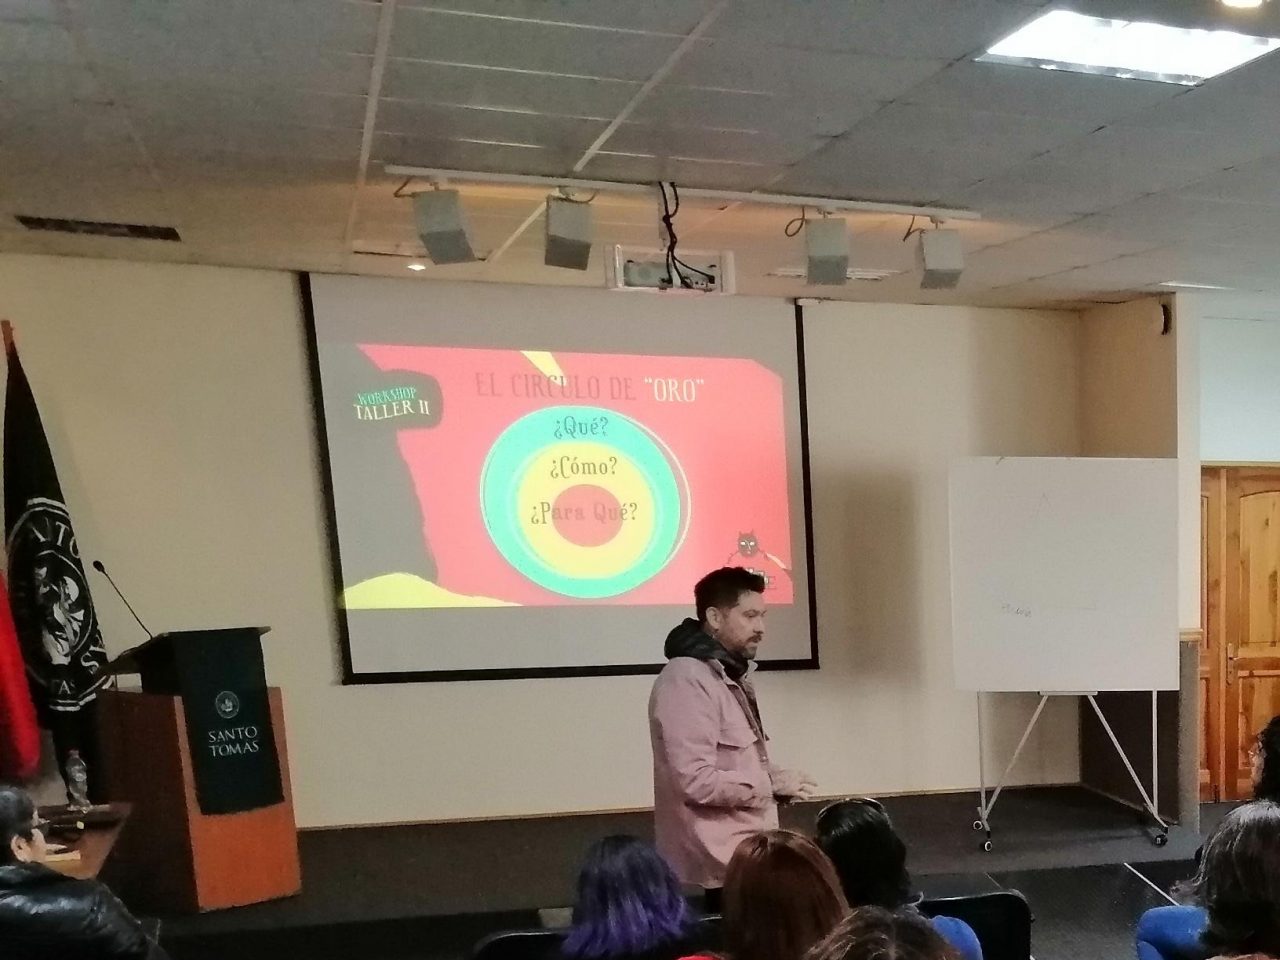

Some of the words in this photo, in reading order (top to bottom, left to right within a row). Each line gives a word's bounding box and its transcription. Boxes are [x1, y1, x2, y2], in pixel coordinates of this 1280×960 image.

[357, 386, 417, 406] WORKSHOP
[474, 372, 503, 398] EL
[511, 373, 602, 400] CIRCULO
[608, 376, 636, 401] DE
[353, 400, 415, 420] TALLER
[553, 415, 609, 440] ¿Qué?
[550, 455, 618, 479] ¿Cómo?
[531, 501, 586, 525] ¿Para
[592, 501, 638, 525] Qué?
[208, 726, 258, 743] SANTO
[208, 740, 260, 757] TOMAS
